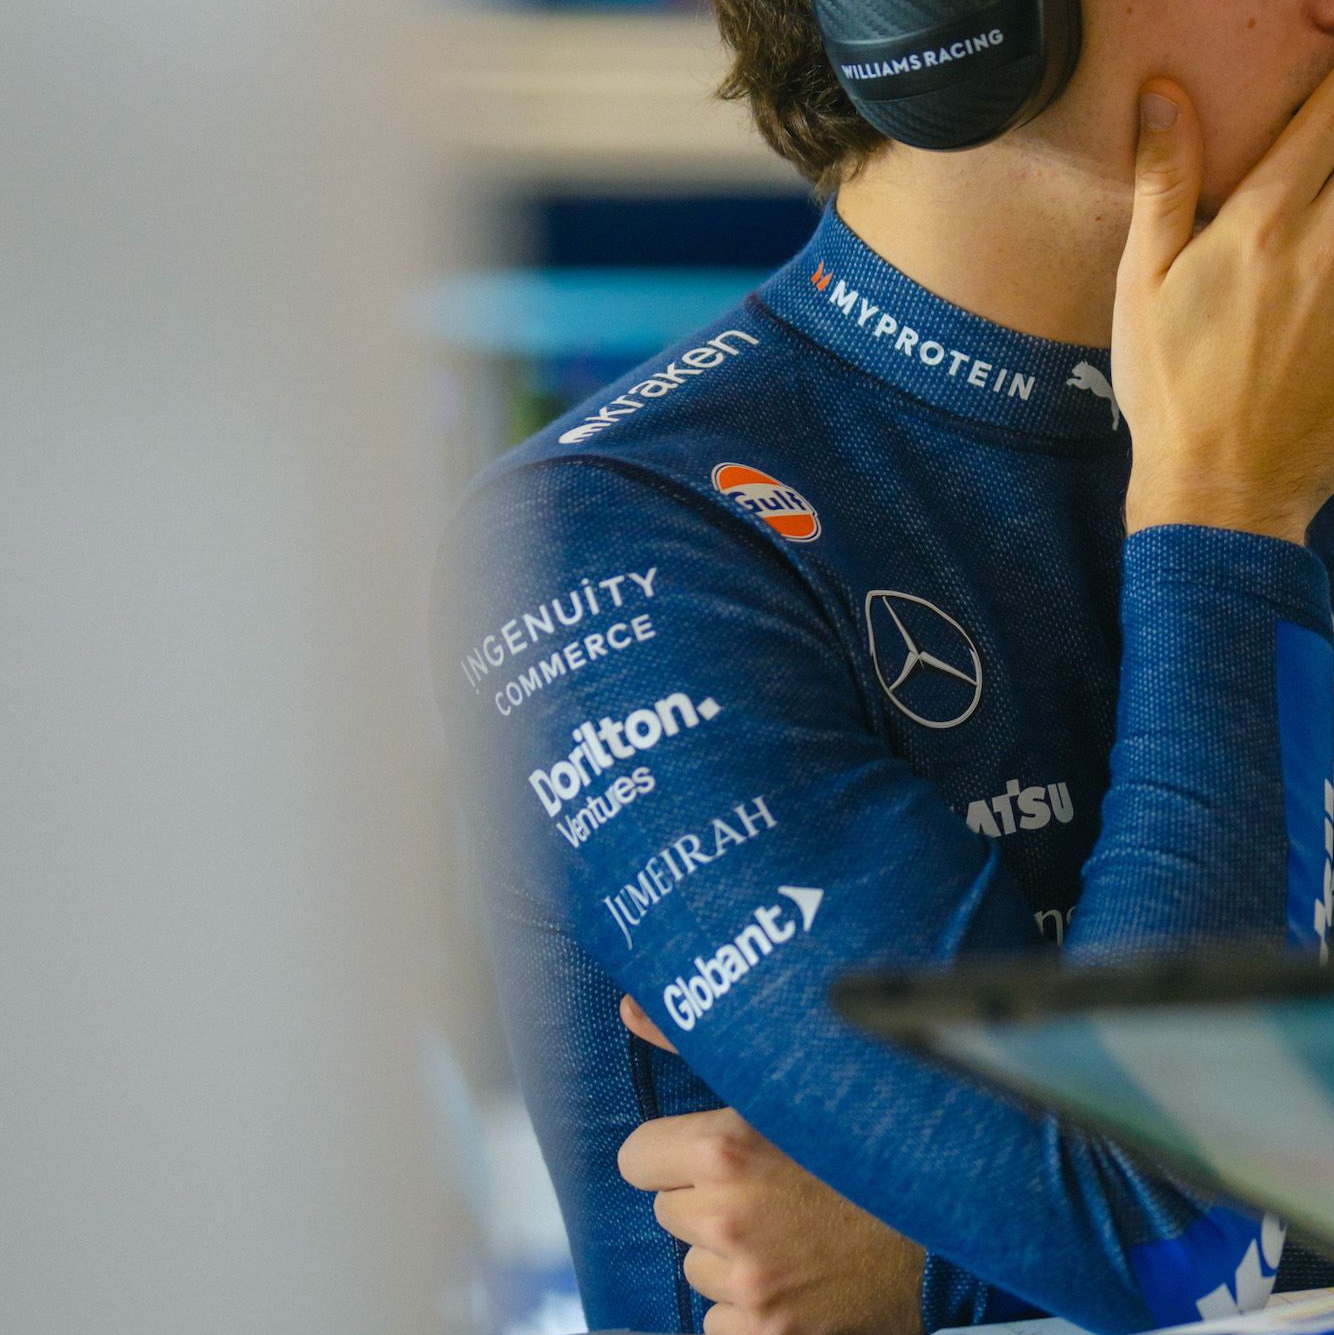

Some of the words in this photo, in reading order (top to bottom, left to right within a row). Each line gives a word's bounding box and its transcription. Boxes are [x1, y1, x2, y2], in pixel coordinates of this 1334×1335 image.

[841, 54, 922, 81] WILLIAMS
[924, 28, 1004, 67] RACING
[584, 330, 759, 422] kraken
[828, 286, 1036, 401] MYPROTEIN
[727, 490, 807, 514] Gulf
[460, 567, 658, 694] INGENUITY
[495, 613, 657, 716] COMMERCE
[557, 766, 656, 850] Ventures
[603, 795, 779, 950] JUMEIRAH
[663, 903, 796, 1031] Globant
